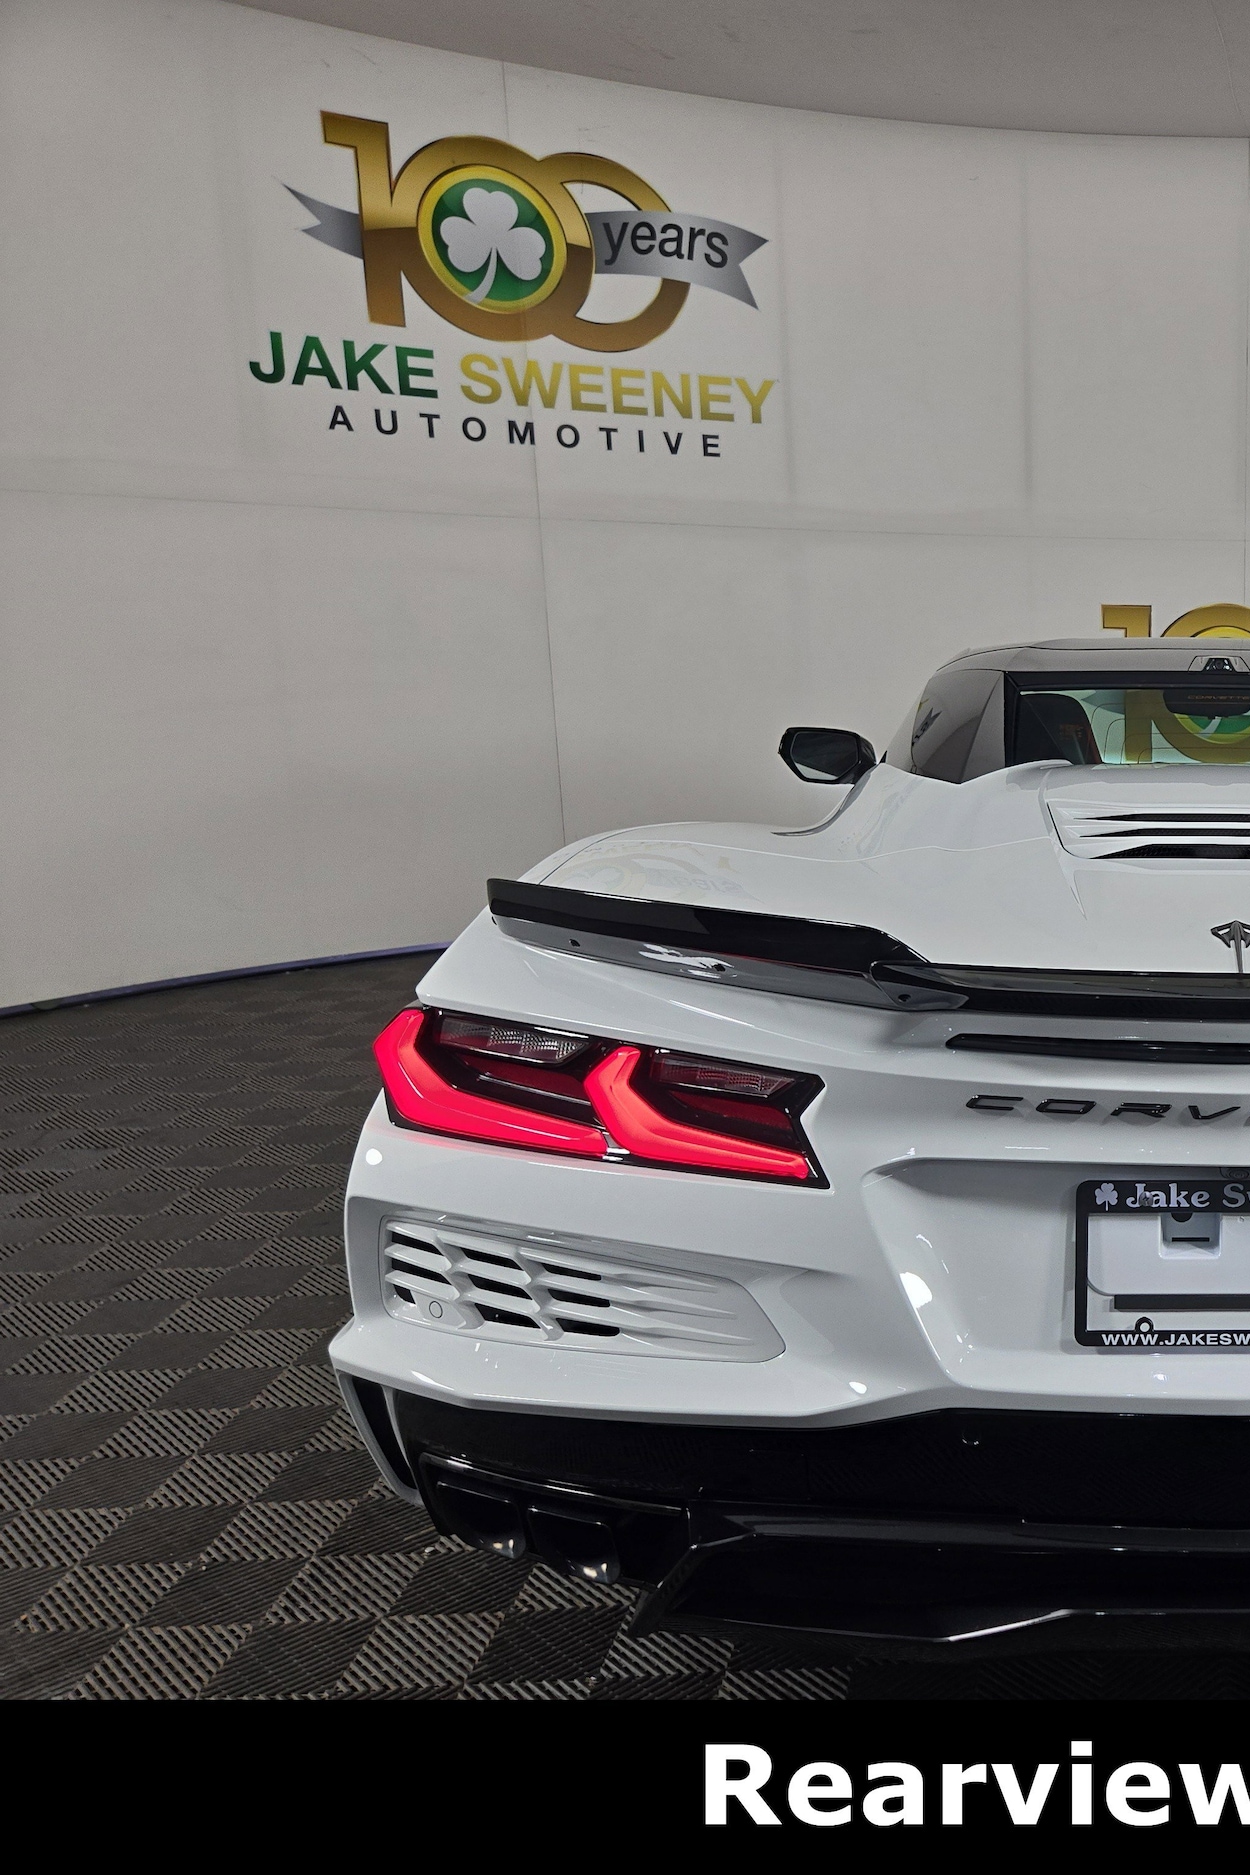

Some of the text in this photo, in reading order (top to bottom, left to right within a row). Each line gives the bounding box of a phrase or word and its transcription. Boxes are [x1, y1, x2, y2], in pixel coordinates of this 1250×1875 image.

[601, 220, 730, 269] years
[248, 330, 776, 425] JAKE SWEENEY
[328, 405, 722, 458] AUTOMOTIVE
[1126, 1183, 1210, 1210] Jake
